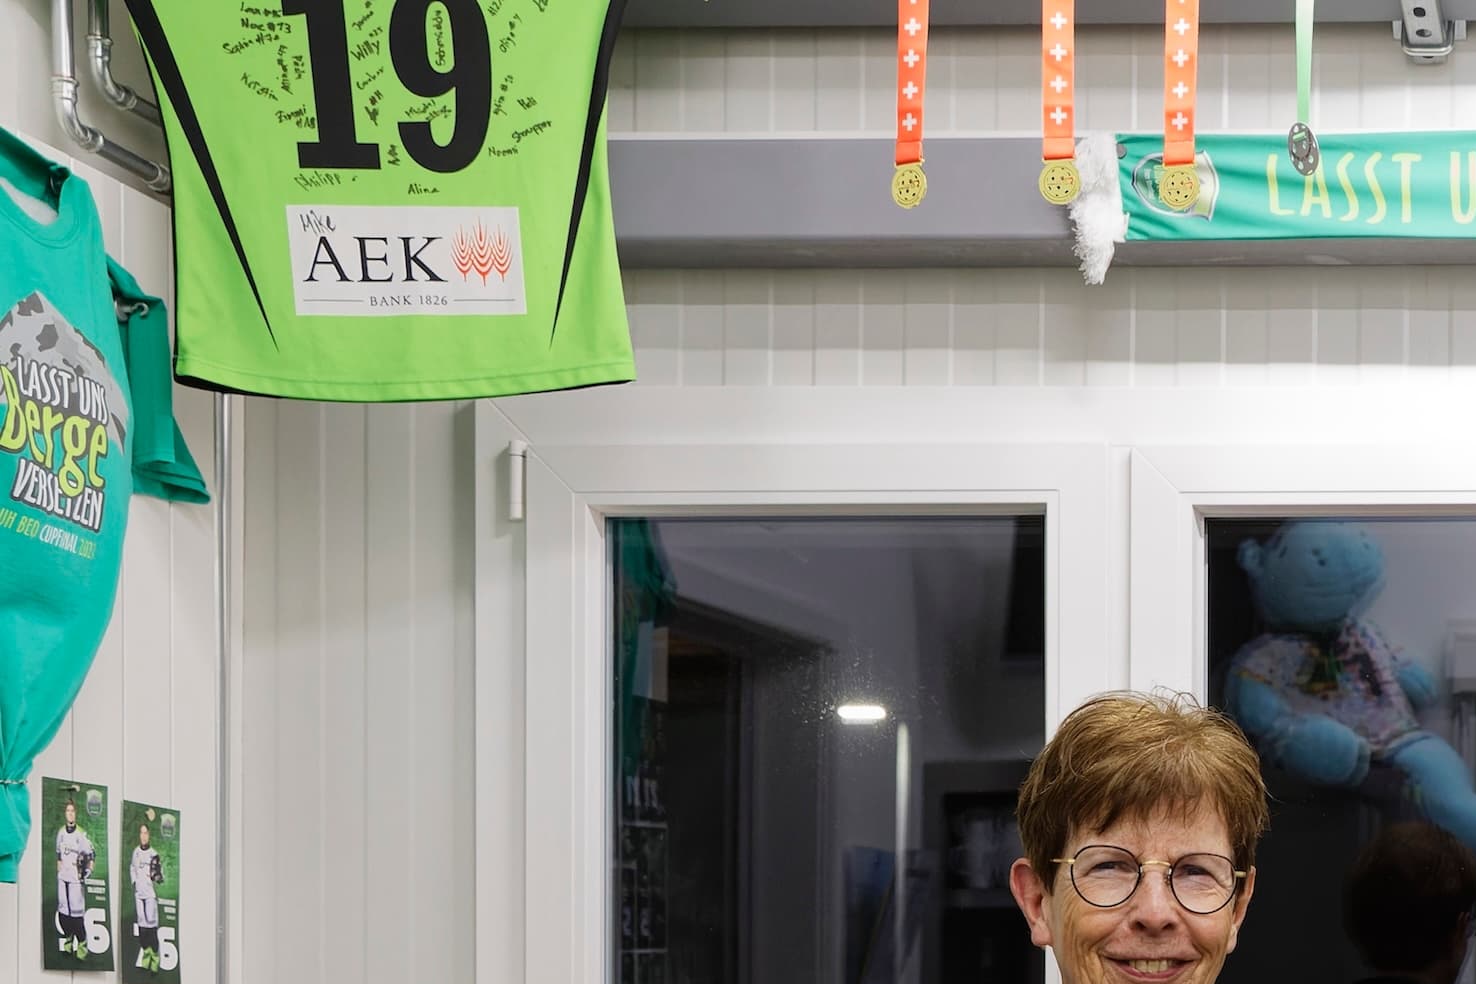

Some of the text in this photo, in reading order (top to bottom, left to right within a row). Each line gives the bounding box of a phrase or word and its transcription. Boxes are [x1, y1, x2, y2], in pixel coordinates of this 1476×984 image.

[281, 0, 492, 174] 19
[407, 183, 440, 196] Alina
[1266, 151, 1422, 225] LASST
[299, 209, 337, 237] Mike
[303, 235, 448, 283] AEK
[369, 295, 448, 307] BANK 1826
[17, 355, 108, 425] LASST UNS
[0, 365, 107, 498] Berge
